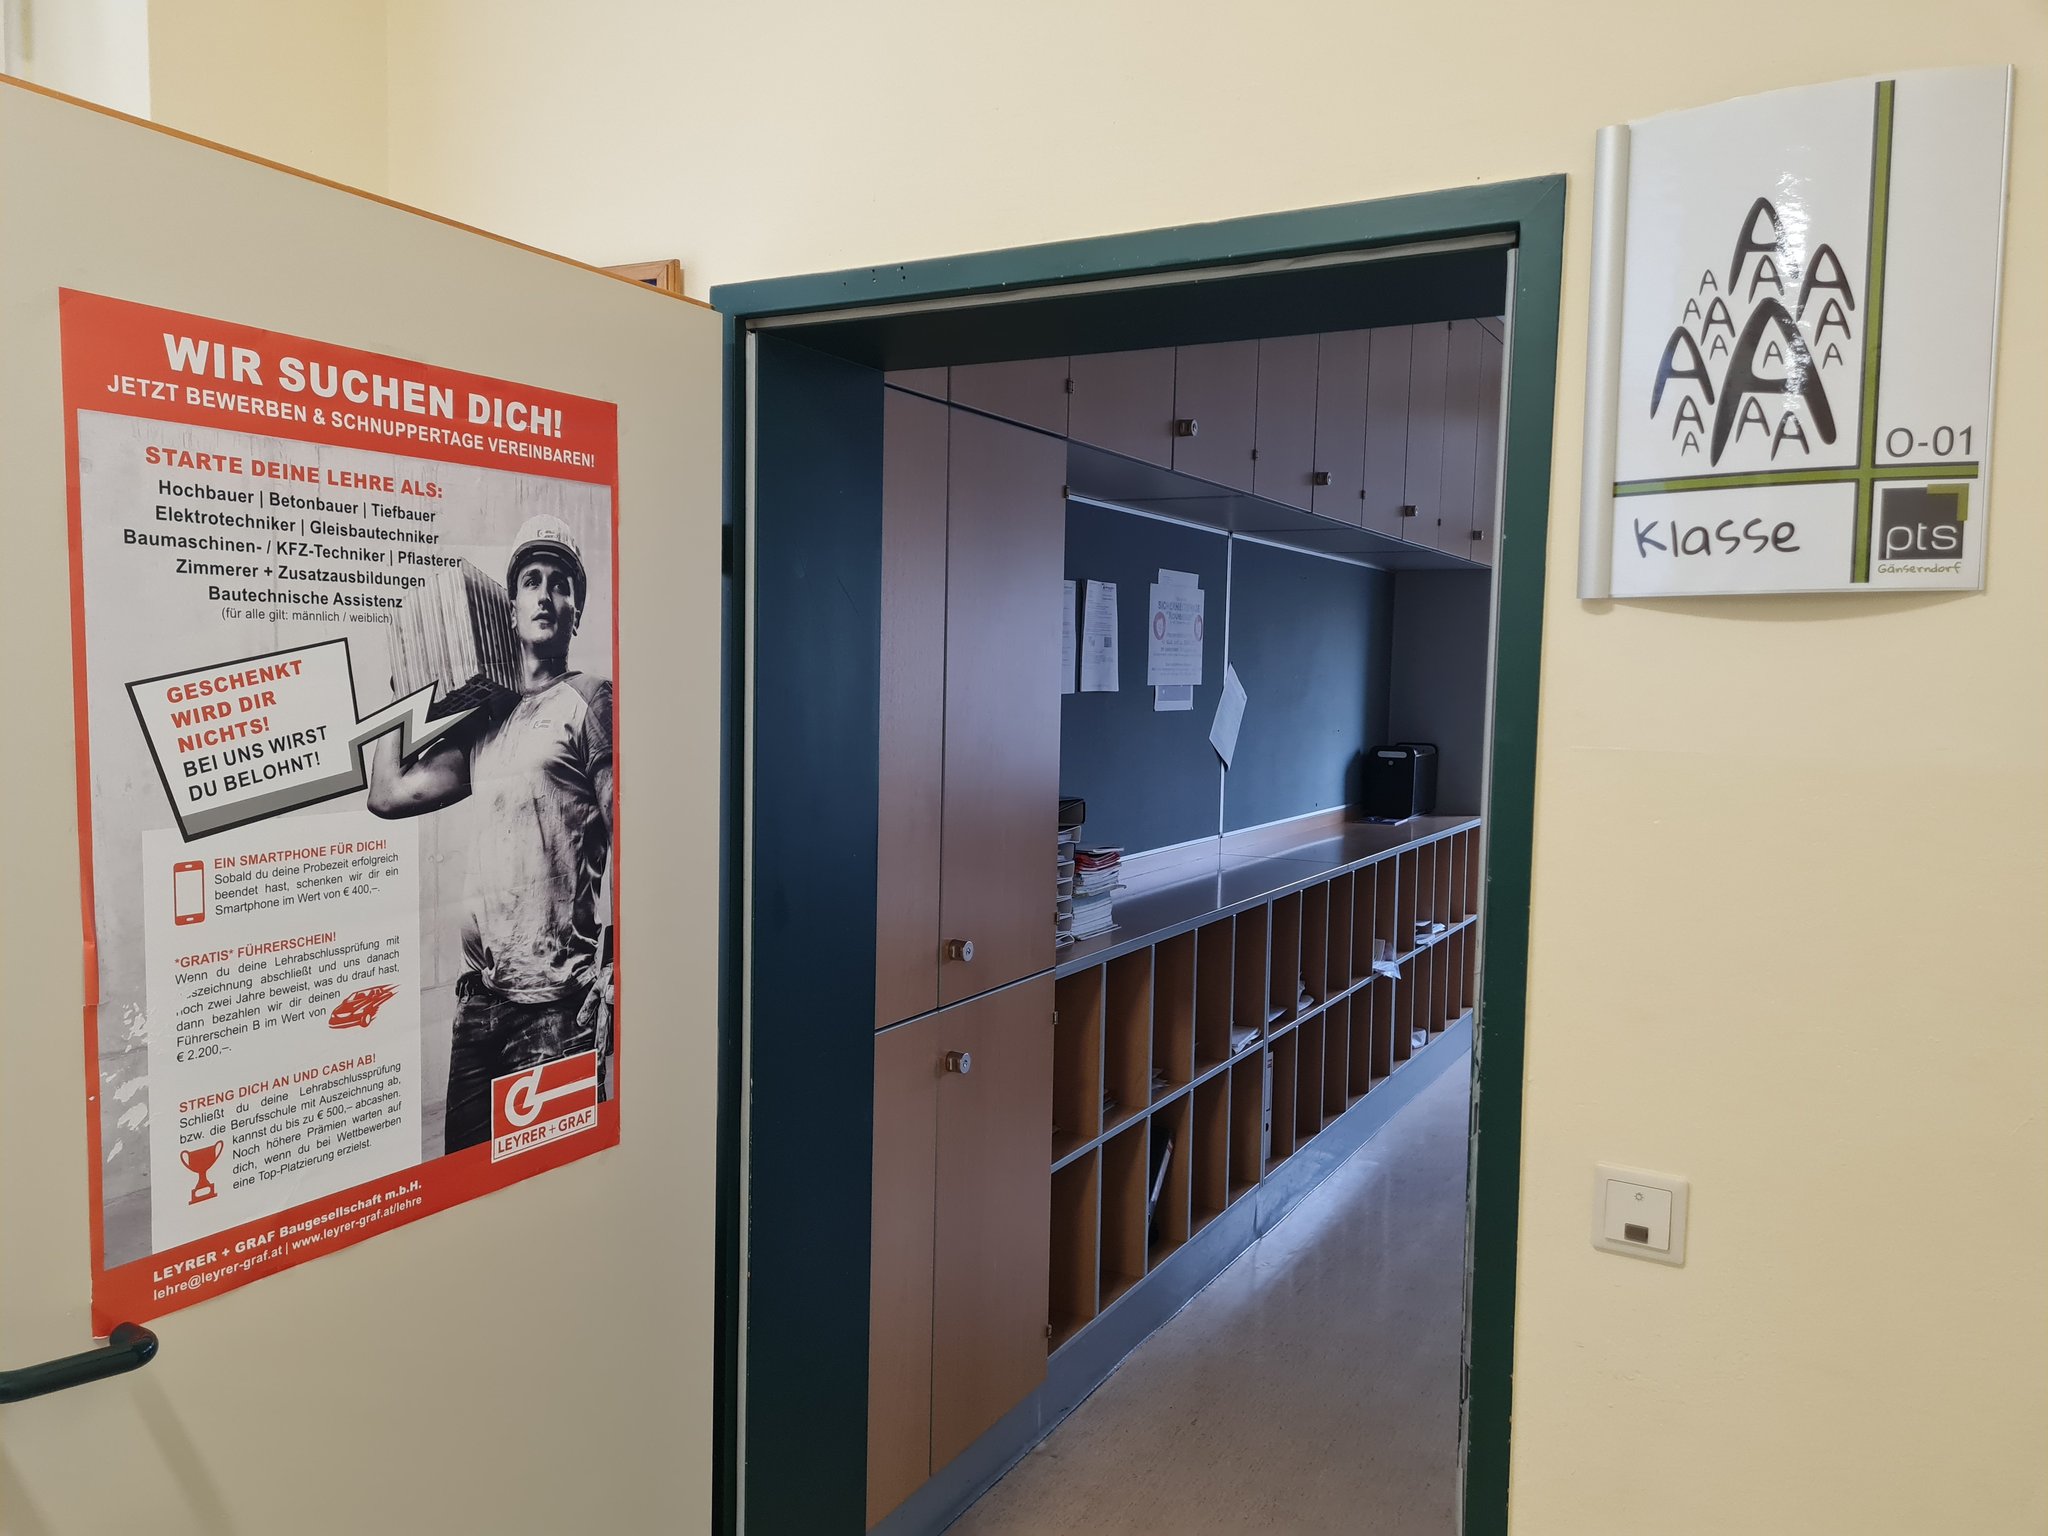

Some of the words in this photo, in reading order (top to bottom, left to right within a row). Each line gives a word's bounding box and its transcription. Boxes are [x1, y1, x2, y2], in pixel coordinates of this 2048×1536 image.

[1748, 255, 1784, 304] A
[1797, 243, 1855, 322] A
[1701, 296, 1735, 346] A
[1814, 298, 1851, 346] A
[163, 333, 263, 386] WIR
[278, 357, 453, 419] SUCHEN
[468, 393, 562, 438] DICH!
[1650, 326, 1714, 420] A
[1710, 297, 1837, 468] A
[107, 374, 178, 401] JETZT
[186, 387, 307, 422] BEWERBEN
[313, 408, 326, 425] &
[331, 411, 484, 450] SCHNUPPERTAGE
[488, 437, 595, 468] VEREINBAREN!
[1672, 395, 1704, 440] A
[1735, 396, 1770, 443] A
[1771, 411, 1809, 461] A
[146, 446, 243, 474] STARTE
[251, 460, 319, 484] DEINE
[327, 470, 394, 492] LEHRE
[401, 479, 443, 498] ALS:
[159, 480, 254, 503] Hochbauer
[269, 492, 358, 514] Betonbauer
[371, 503, 435, 522] Tiefbauer
[156, 505, 296, 532] Elektrotechniker
[310, 520, 439, 544] Gleisbautechniker
[1633, 517, 1800, 558] Klasse
[1885, 523, 1957, 559] pts
[124, 529, 262, 553] Baumaschinen-
[277, 541, 385, 562] KFZ-Techniker
[398, 551, 462, 568] Pflasterer
[1878, 562, 1962, 574] Gänserndorf
[176, 559, 258, 577] Zimmerer
[278, 565, 426, 589] Zusatzausbildungen
[208, 586, 328, 605] Bautechnische
[333, 592, 403, 608] Assistenz
[221, 607, 241, 620] (für
[246, 608, 265, 619] alle
[269, 609, 288, 622] gilt:
[292, 610, 339, 622] männlich
[350, 612, 393, 625] weiblich)
[166, 660, 302, 703] GESCHENKT
[171, 702, 232, 728] WIRD
[239, 691, 277, 713] DIR
[177, 717, 269, 753] NICHTS!
[183, 755, 218, 778] BEI
[223, 743, 264, 766] UNS
[269, 726, 327, 753] WIRST
[189, 780, 217, 801] DU
[224, 752, 320, 791] BELOHNT!
[214, 857, 235, 869] EIN
[240, 846, 326, 866] SMARTPHONE
[331, 842, 353, 856] FÜR
[356, 840, 387, 853] DICH!
[214, 871, 251, 884] Sobald
[255, 868, 268, 879] du
[272, 866, 300, 877] deine
[304, 859, 349, 873] Probezeit
[351, 852, 398, 867] erfolgreich
[215, 886, 258, 900] beendet
[296, 875, 343, 889] schenken
[349, 871, 362, 881] wir
[369, 869, 381, 879] dir
[386, 867, 399, 877] ein
[215, 898, 280, 915] Smartphone
[283, 895, 295, 905] im
[298, 892, 321, 903] Wert
[323, 890, 341, 900] von
[343, 887, 350, 896] €
[175, 971, 208, 984] Wenn
[216, 967, 230, 980] du
[238, 961, 267, 973] deine
[275, 940, 380, 966] Lehrabschlussprüfung
[386, 936, 400, 946] mit
[238, 932, 336, 958] FÜHRERSCHEIN!
[185, 979, 252, 999] szeichnung
[260, 966, 312, 984] abschließt
[319, 963, 337, 973] und
[343, 958, 360, 968] uns
[367, 950, 400, 963] danach
[208, 995, 232, 1009] zwei
[236, 990, 265, 1004] Jahre
[314, 977, 333, 987] was
[337, 973, 348, 983] du
[351, 968, 375, 981] drauf
[176, 1019, 205, 1032] dann
[212, 1006, 260, 1024] bezahlen
[267, 1001, 282, 1012] wir
[289, 996, 301, 1007] dir
[308, 990, 341, 1003] deinen
[177, 1024, 248, 1046] Führerschein
[253, 1020, 260, 1030] B
[265, 1017, 277, 1028] im
[281, 1012, 305, 1024] Wert
[309, 1007, 326, 1018] von
[177, 1052, 184, 1062] €
[179, 1090, 235, 1113] STRENG
[239, 1081, 268, 1097] DICH
[272, 1076, 289, 1089] AN
[293, 1069, 319, 1083] UND
[322, 1060, 354, 1076] CASH
[357, 1053, 376, 1067] AB!
[180, 1109, 224, 1129] Schließt
[236, 1103, 249, 1114] du
[260, 1092, 289, 1107] deine
[299, 1063, 401, 1096] Lehrabschlussprüfung
[210, 1124, 226, 1136] die
[231, 1104, 297, 1130] Berufsschule
[301, 1099, 316, 1111] mit
[319, 1081, 384, 1106] Auszeichnung
[232, 1129, 267, 1144] kannst
[270, 1122, 283, 1133] du
[286, 1118, 300, 1129] bis
[303, 1113, 314, 1124] zu
[317, 1110, 324, 1120] €
[232, 1145, 260, 1159] Noch
[266, 1133, 301, 1149] höhere
[307, 1118, 347, 1137] Prämien
[352, 1109, 383, 1124] warten
[388, 1101, 402, 1114] auf
[264, 1150, 291, 1165] wenn
[298, 1144, 310, 1154] du
[317, 1137, 331, 1149] bei
[337, 1117, 402, 1142] Wettbewerben
[498, 1126, 546, 1153] LEYRER
[559, 1110, 592, 1132] GRAF
[233, 1175, 255, 1190] eine
[258, 1151, 334, 1180] Top-Platzierung
[153, 1250, 217, 1282] LEYRER
[235, 1230, 275, 1253] GRAF
[279, 1193, 381, 1237] Baugesellschaft
[153, 1245, 282, 1301] lehre@leyrer-graf.at
[292, 1195, 422, 1250] www.leyrer-graf.at/lehre
